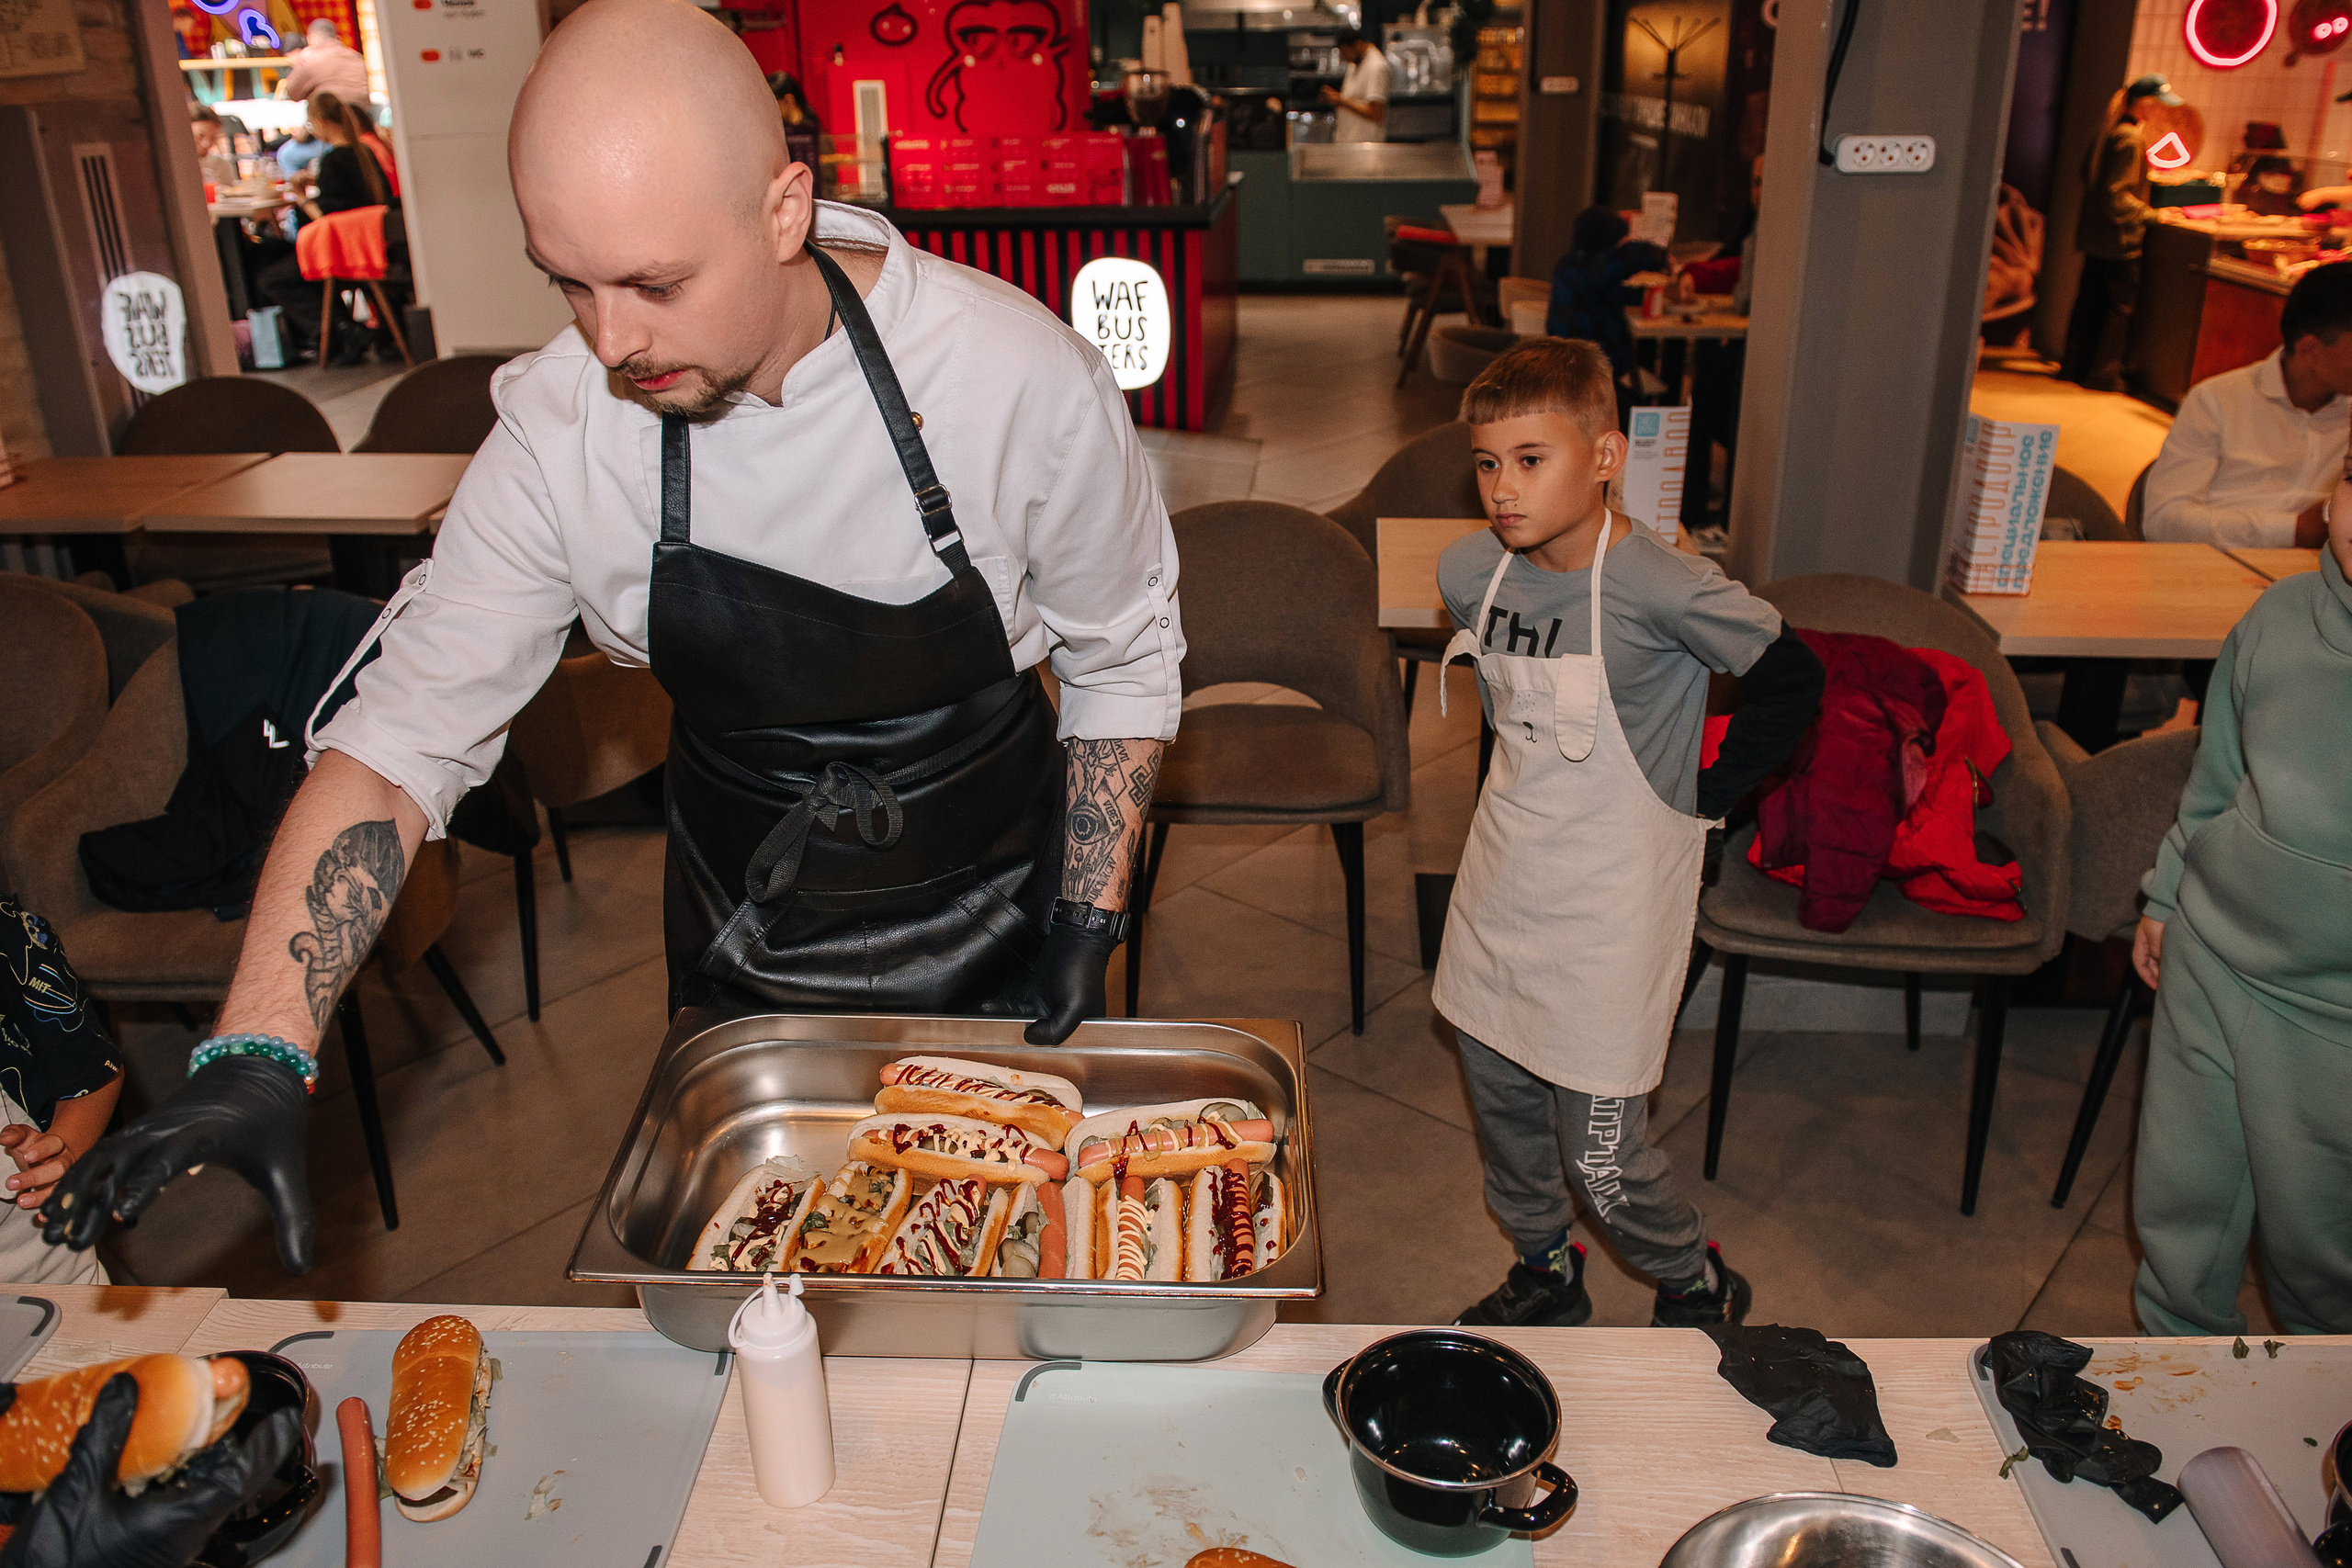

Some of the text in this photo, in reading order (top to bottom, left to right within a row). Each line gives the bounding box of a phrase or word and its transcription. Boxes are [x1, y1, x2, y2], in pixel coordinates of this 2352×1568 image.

[1092, 280, 1148, 311] WAF
[1097, 314, 1148, 341] BUS
[1102, 799, 1122, 827] VIBES
